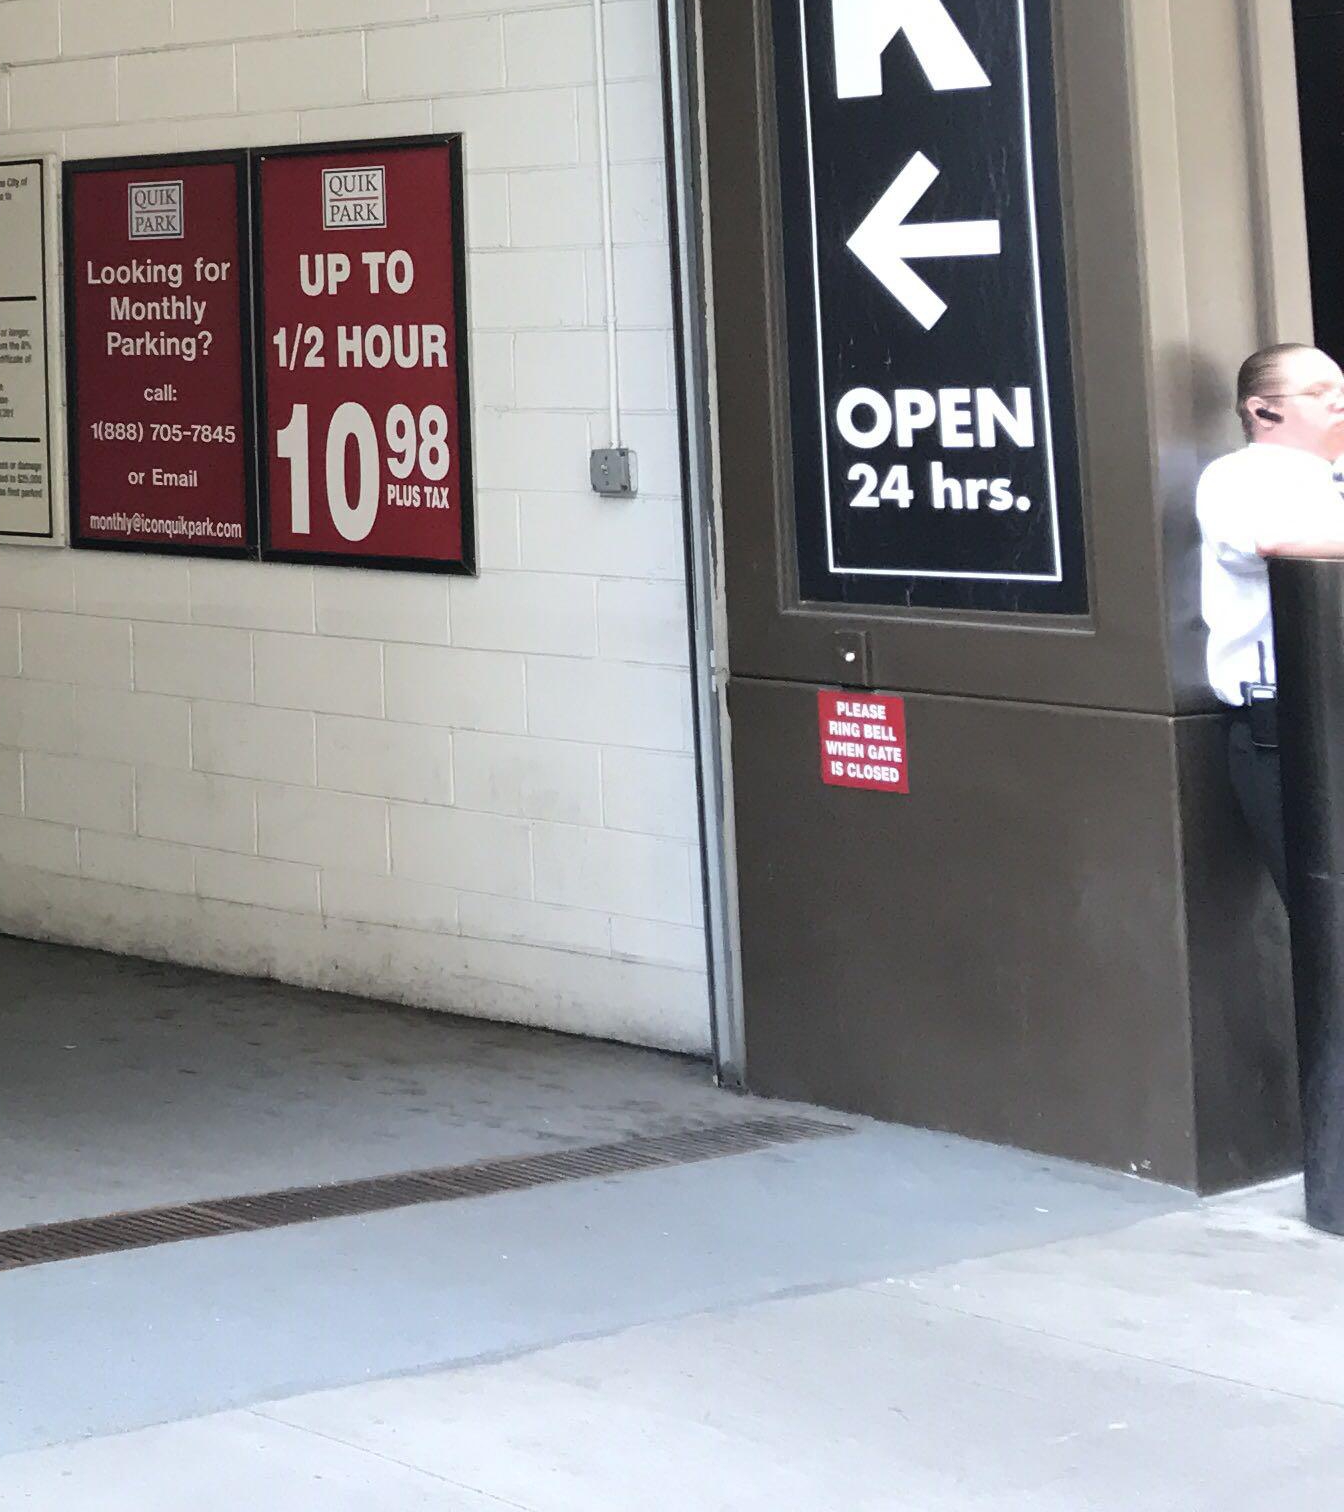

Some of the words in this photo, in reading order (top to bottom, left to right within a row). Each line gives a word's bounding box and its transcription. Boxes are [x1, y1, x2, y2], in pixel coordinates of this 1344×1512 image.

[328, 169, 379, 196] QUIK
[134, 188, 178, 209] QUIK
[134, 215, 179, 233] PARK
[329, 202, 380, 223] PARK
[87, 259, 183, 288] Looking
[194, 257, 231, 283] for
[299, 253, 350, 296] UP
[361, 249, 415, 294] TO
[110, 295, 207, 325] Monthly
[106, 331, 213, 362] Parking?
[272, 323, 325, 371] 1/2
[337, 323, 449, 369] HOUR
[143, 385, 178, 402] call:
[836, 386, 1035, 449] OPEN
[90, 423, 144, 443] 1(888)
[149, 424, 236, 444] 705-7845
[127, 470, 146, 486] or
[152, 468, 198, 488] Email
[276, 401, 380, 542] 10
[385, 403, 451, 481] 98
[387, 484, 421, 507] PLUS
[424, 486, 450, 509] TAX
[846, 462, 914, 509] 24
[930, 461, 1032, 512] hrs.
[89, 511, 243, 539] monthly@iconquikpark.com
[836, 700, 887, 720] PLEASE
[828, 720, 861, 738] RING
[863, 723, 897, 742] BELL
[825, 740, 865, 758] WHEN
[867, 744, 903, 763] GATE
[830, 760, 844, 777] IS
[846, 762, 900, 783] CLOSED
